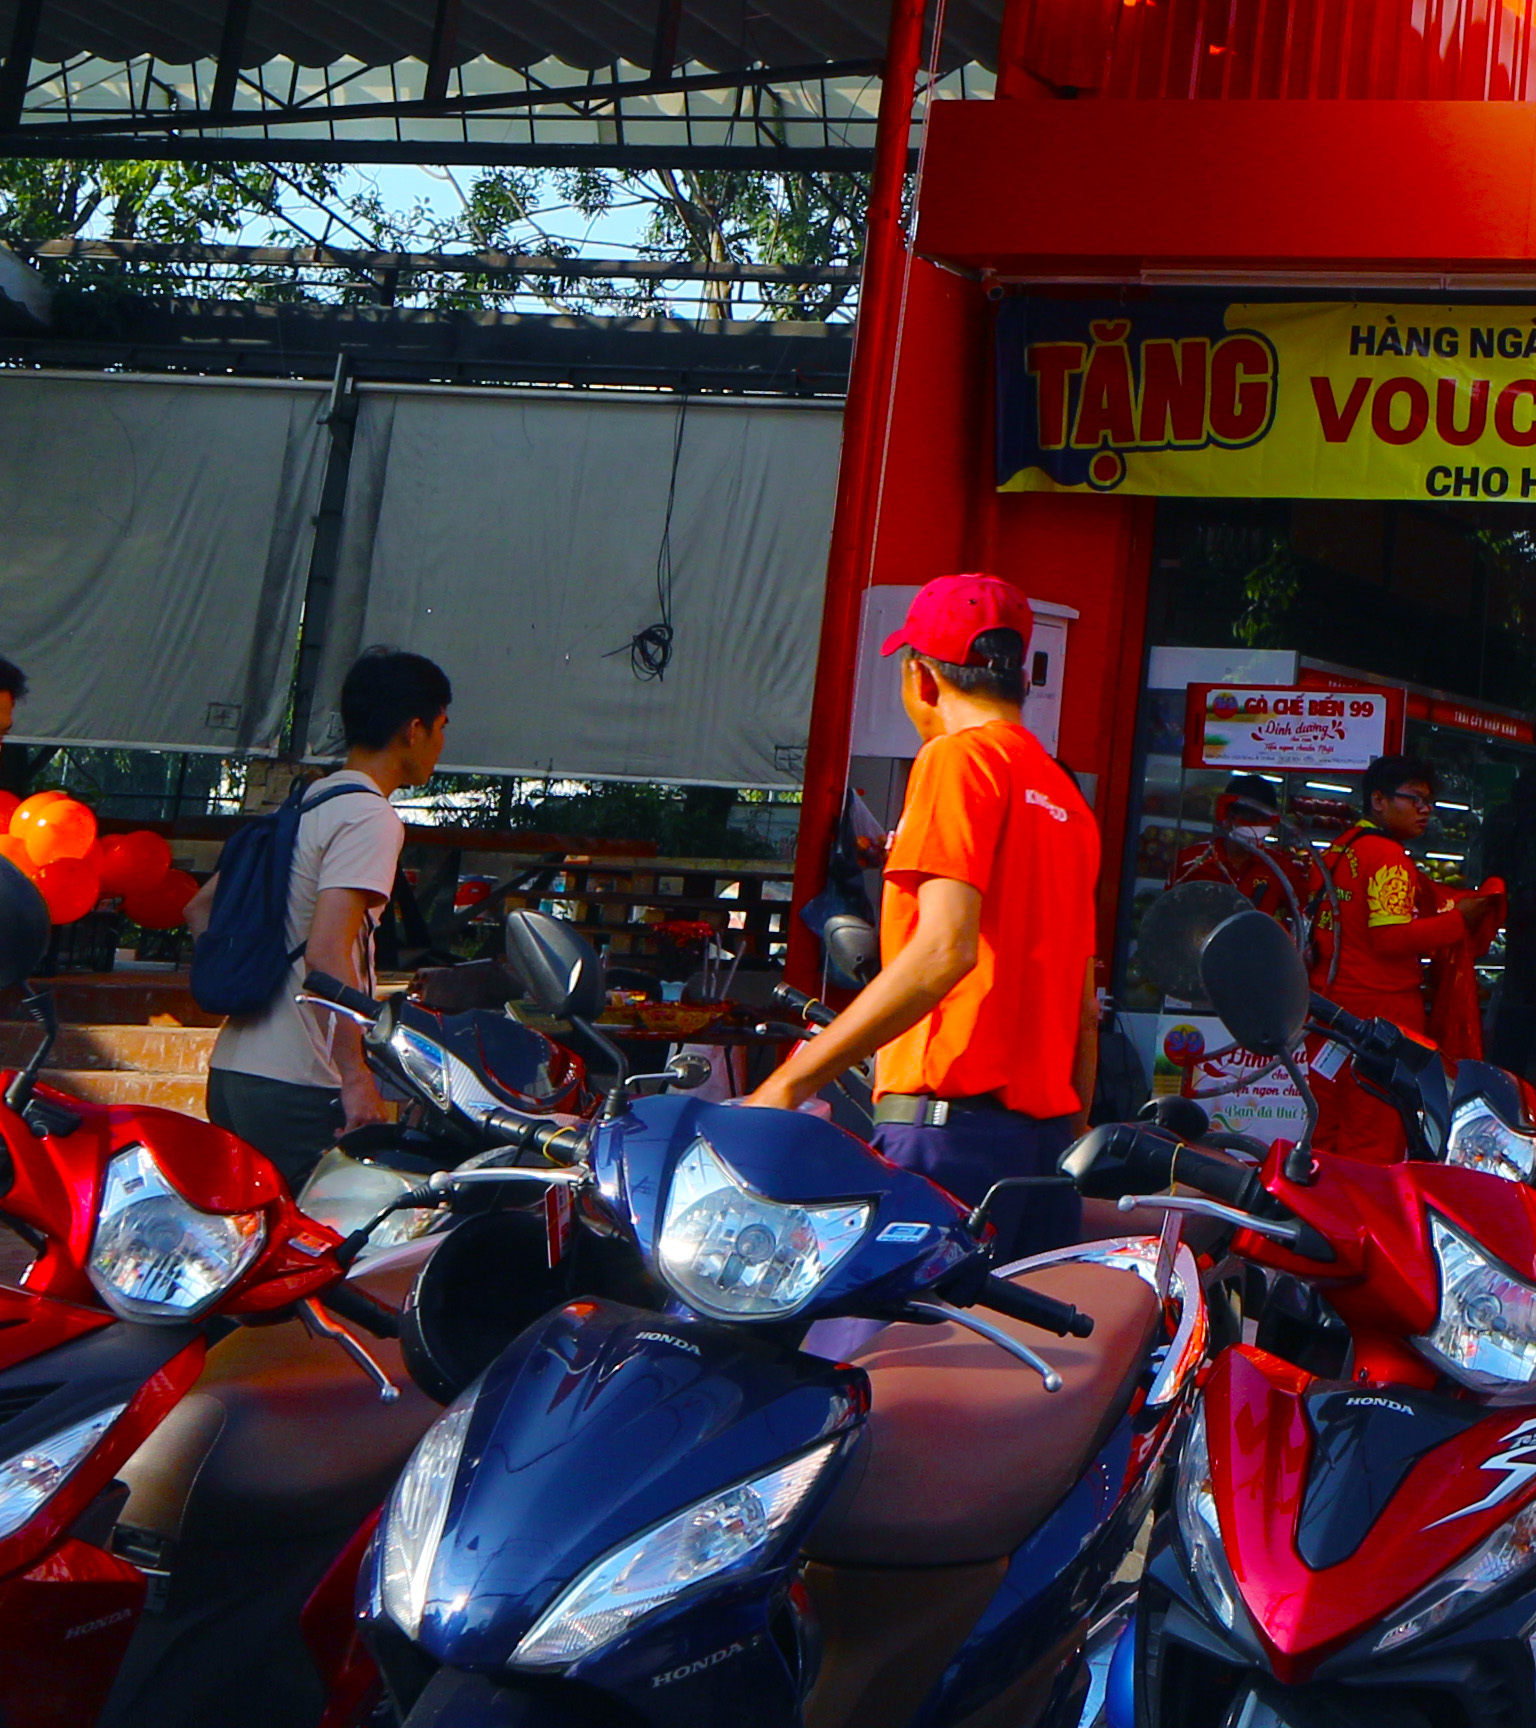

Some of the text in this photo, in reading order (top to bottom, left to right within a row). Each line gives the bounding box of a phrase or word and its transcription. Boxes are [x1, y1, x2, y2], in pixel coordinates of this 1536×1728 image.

[1350, 318, 1459, 359] HÀNG
[1026, 320, 1276, 488] TẶNG
[1425, 465, 1508, 499] CHO
[1349, 700, 1375, 718] 99
[635, 1331, 702, 1357] HONDA
[1346, 1397, 1416, 1417] HONDA
[64, 1608, 133, 1641] HONDA
[652, 1642, 745, 1689] HONDA
